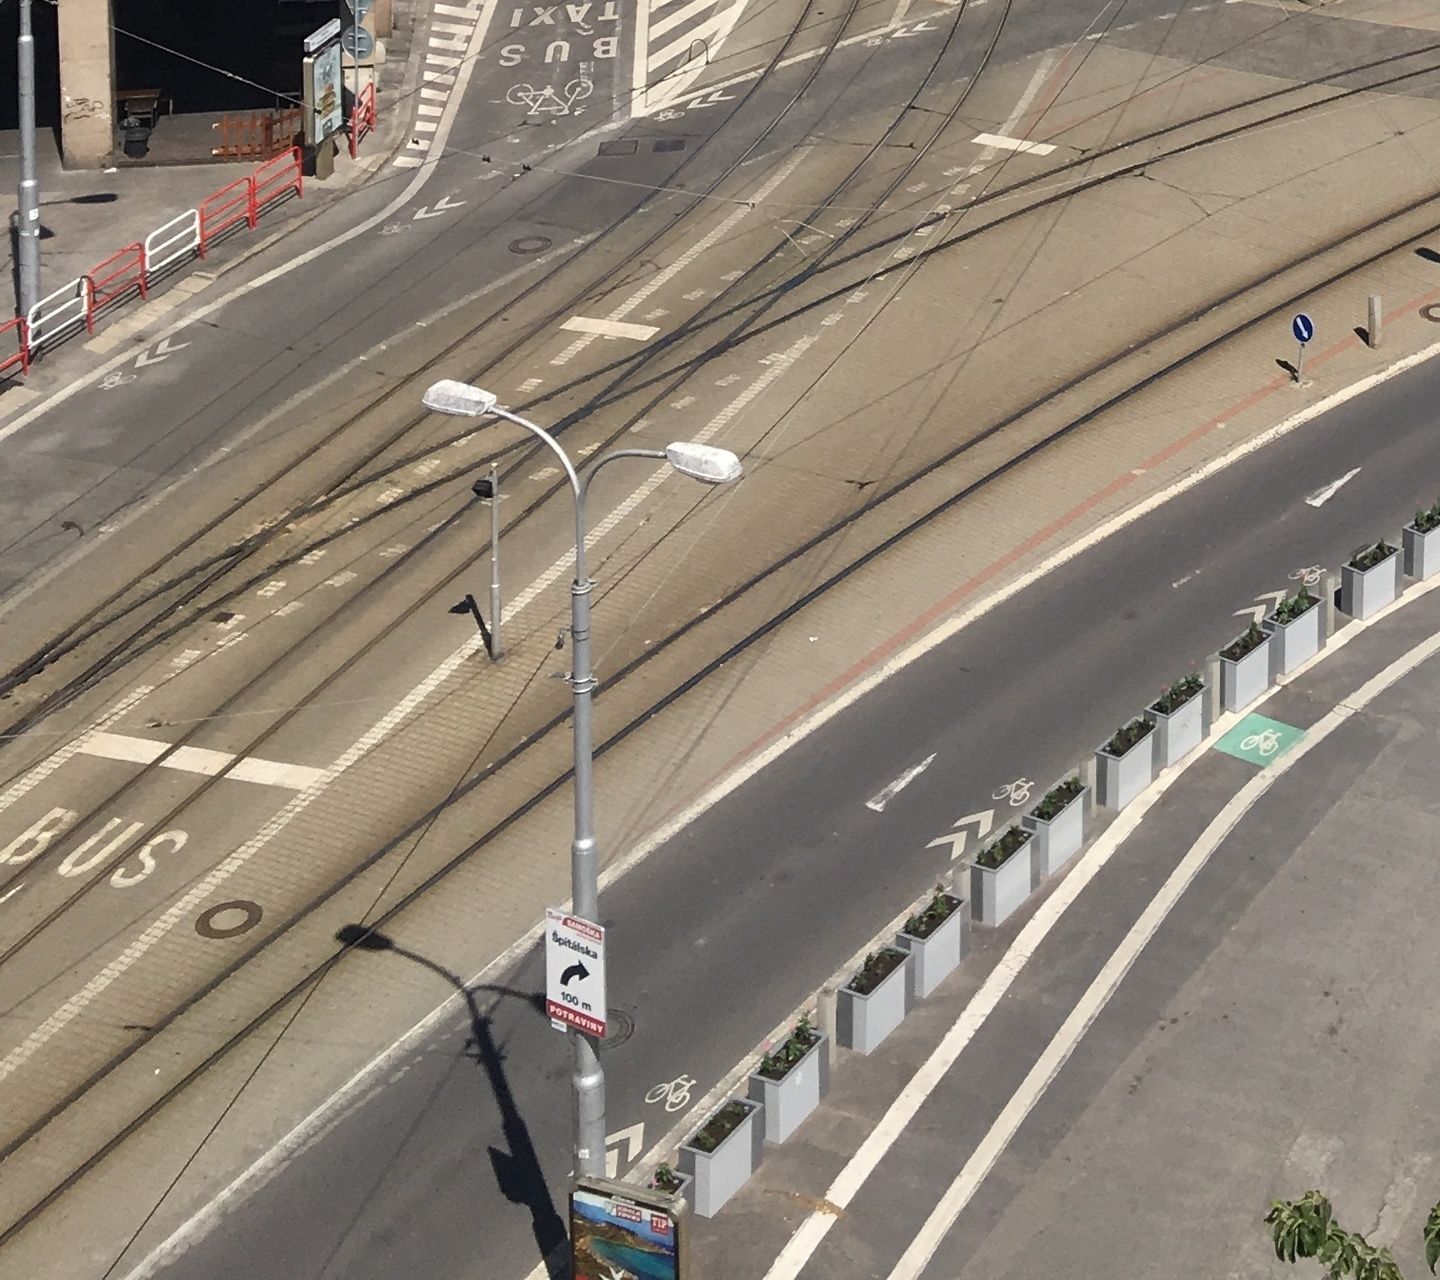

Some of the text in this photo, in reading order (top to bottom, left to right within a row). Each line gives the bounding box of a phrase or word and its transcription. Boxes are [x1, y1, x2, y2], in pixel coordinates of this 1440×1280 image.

[510, 1, 620, 28] TAXI
[498, 36, 619, 67] BUS
[0, 806, 189, 889] BUS
[551, 930, 598, 960] Špitálska
[560, 991, 592, 1013] 100 m
[549, 1004, 604, 1034] POTRAVINY
[651, 1216, 667, 1229] TIP
